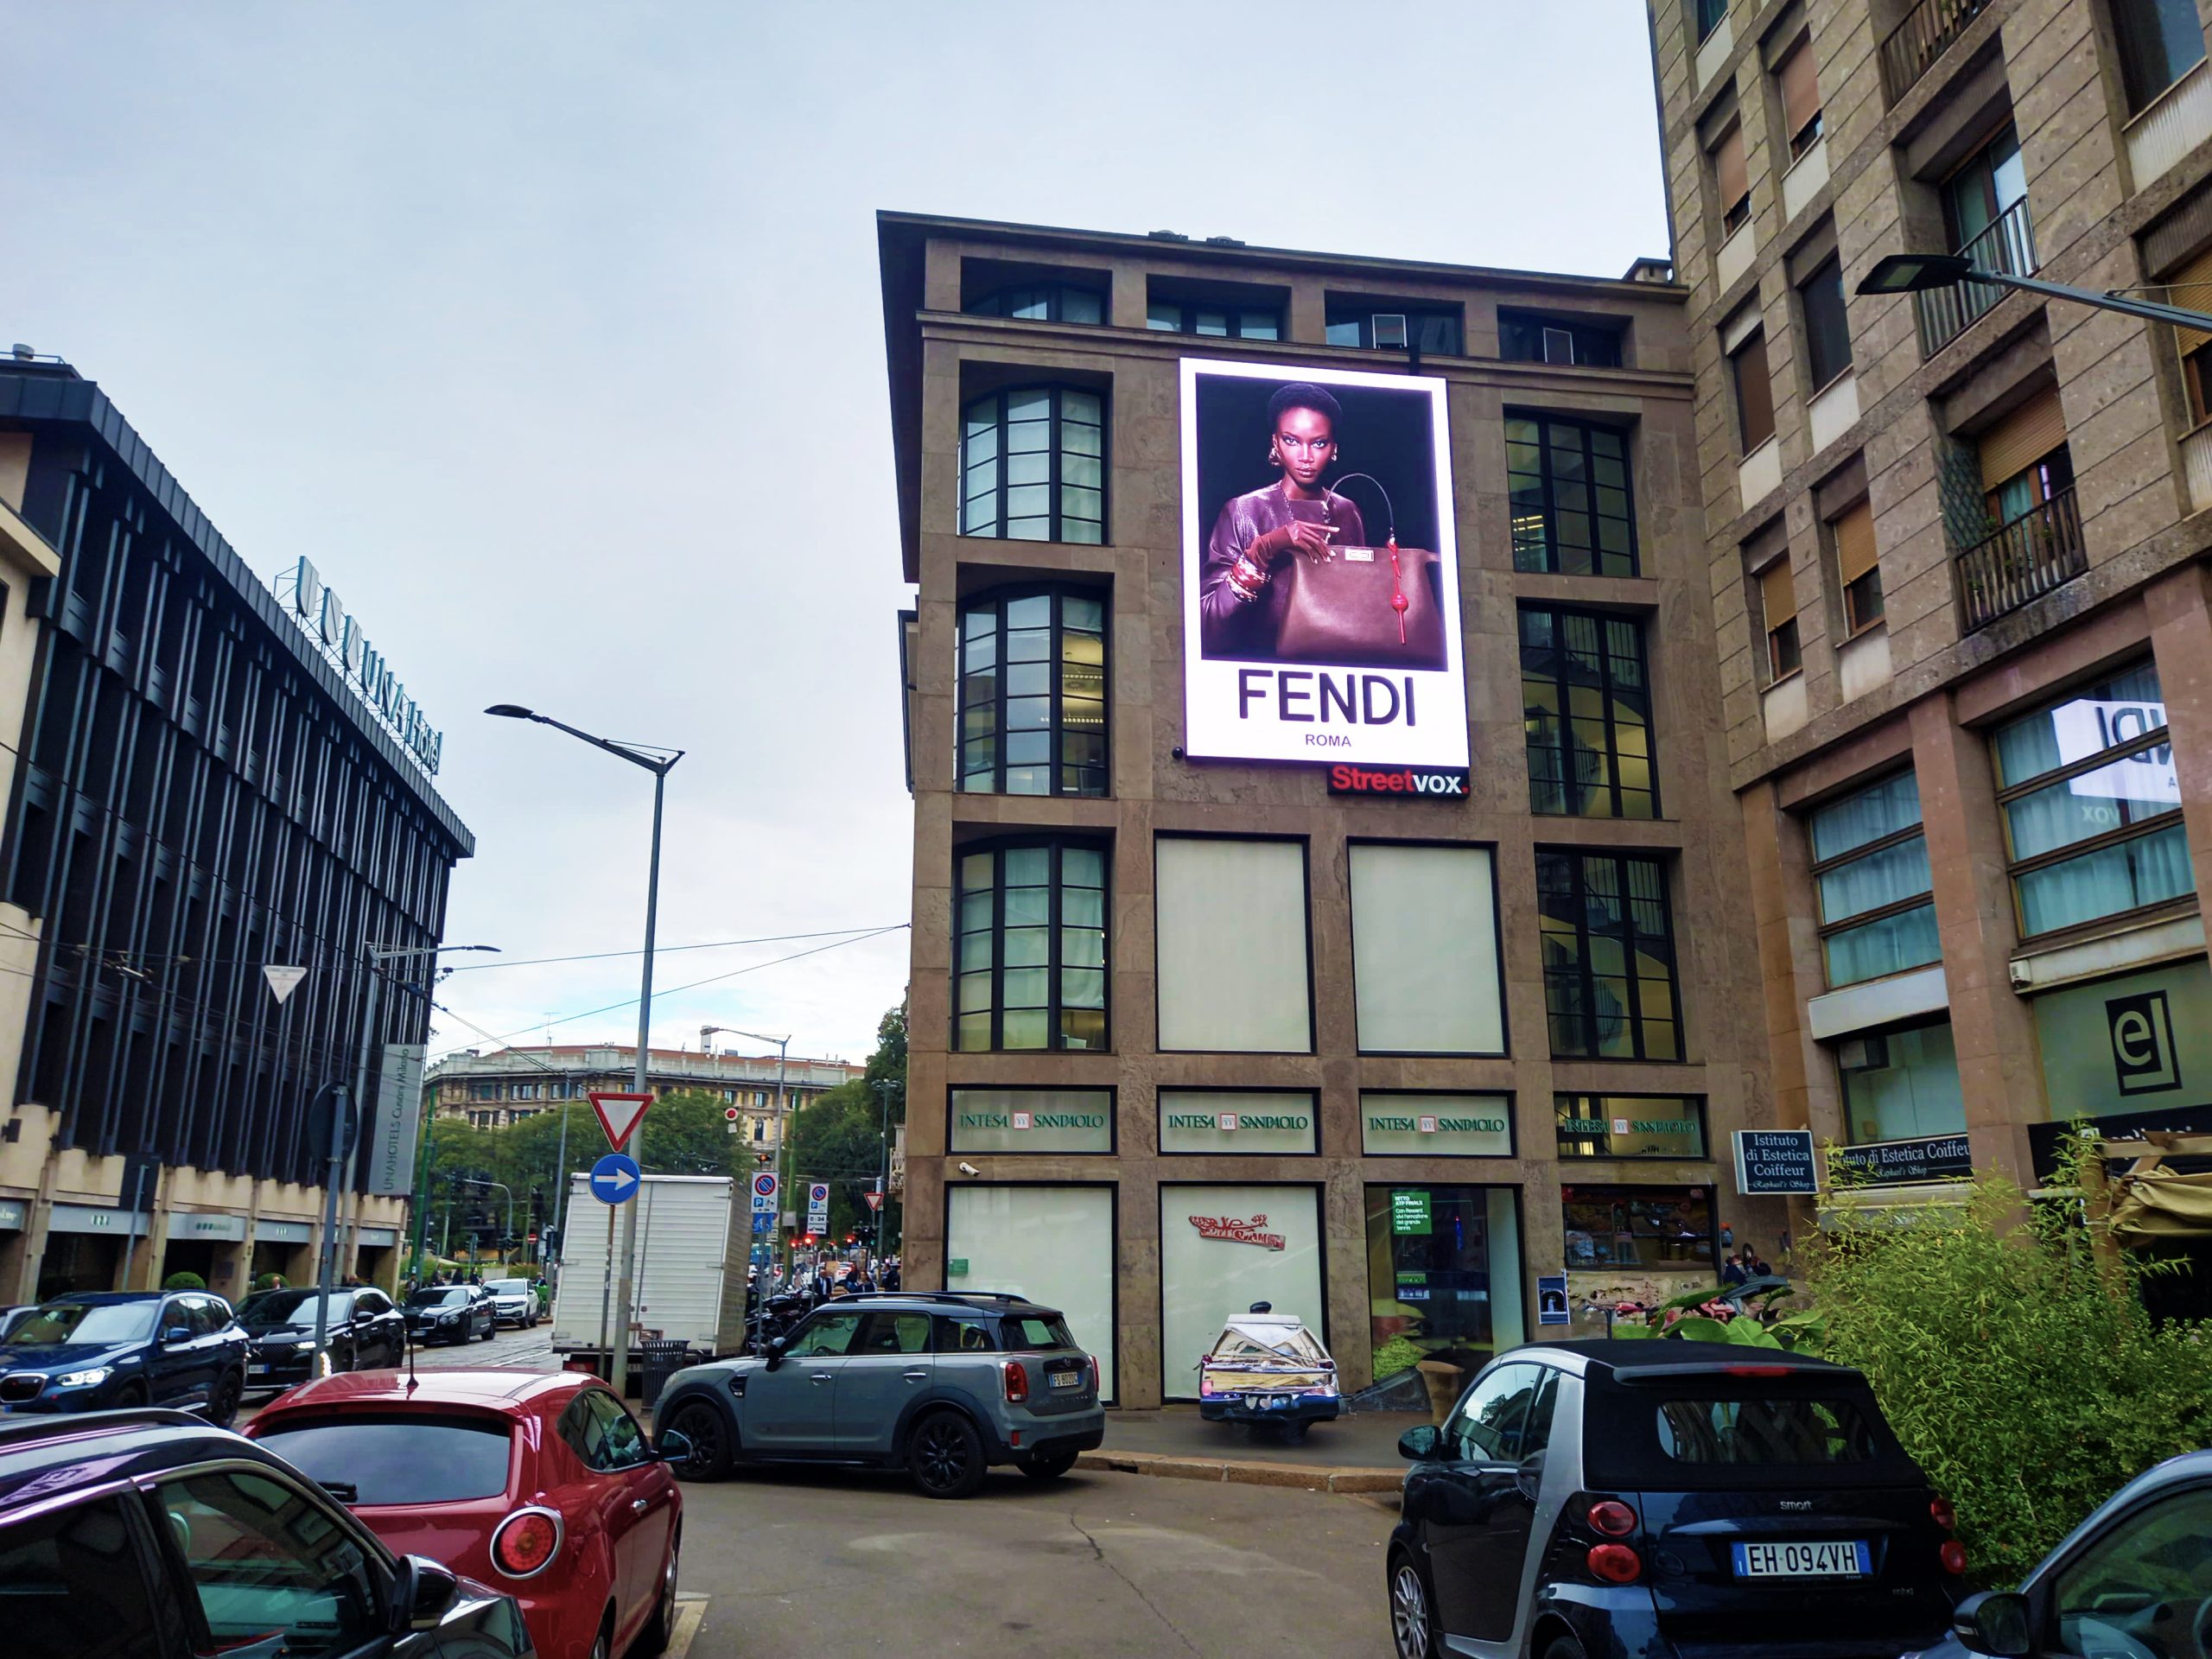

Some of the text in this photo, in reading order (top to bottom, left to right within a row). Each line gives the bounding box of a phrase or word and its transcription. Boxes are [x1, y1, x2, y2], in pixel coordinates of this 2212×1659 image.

[1238, 668, 1416, 727] FENDI
[1305, 734, 1352, 747] ROMA
[384, 1121, 401, 1190] UNAHOTELS
[397, 1048, 410, 1083] Milano
[960, 1114, 1104, 1128] INTESA SANPAOLO
[1168, 1115, 1308, 1129] INTESA SANPAOLO
[1369, 1117, 1505, 1132] INTESA SANPAOLO
[1565, 1119, 1696, 1134] INTESA SANPAOLO
[1754, 1134, 1799, 1147] Istituto
[1745, 1148, 1810, 1161] di Estetica
[1869, 1149, 1879, 1164] di
[1881, 1145, 1925, 1163] Estetica
[1753, 1164, 1806, 1176] Coiffeur
[1780, 1500, 1814, 1510] smart
